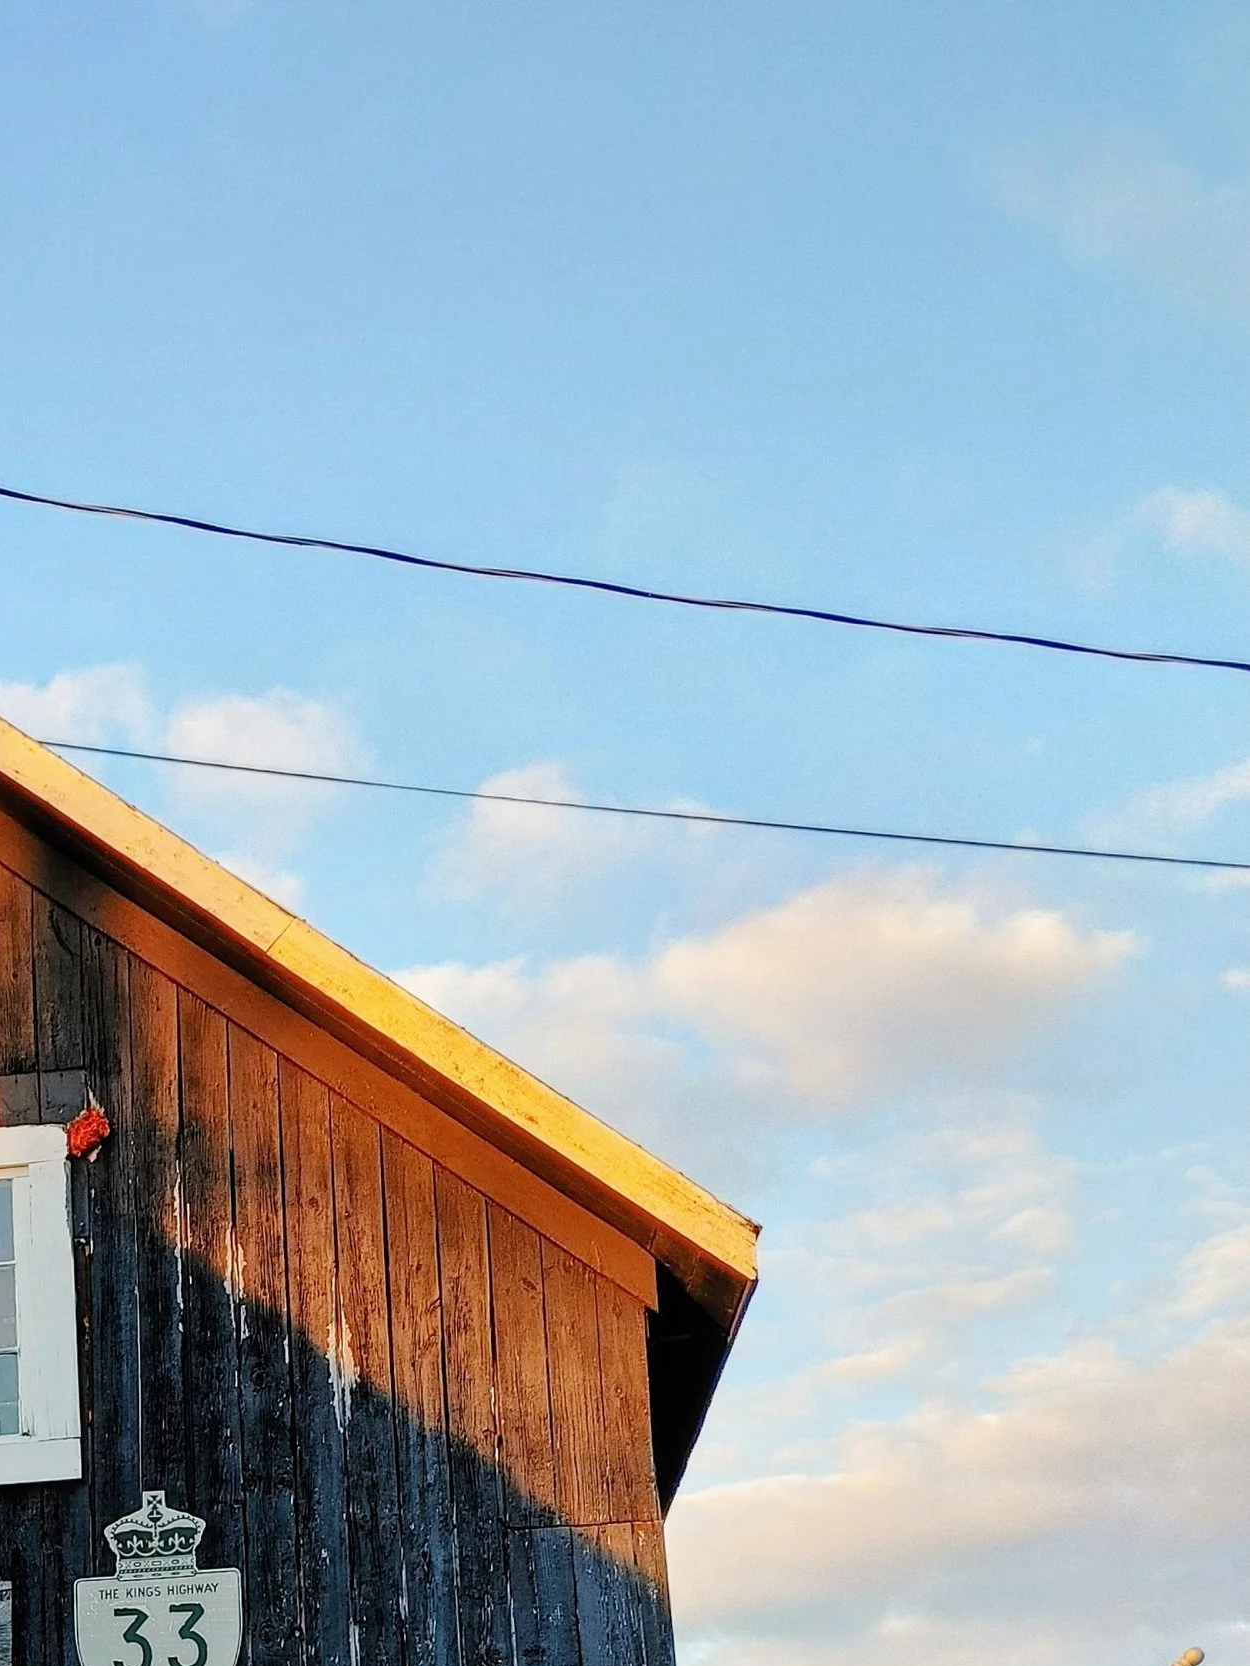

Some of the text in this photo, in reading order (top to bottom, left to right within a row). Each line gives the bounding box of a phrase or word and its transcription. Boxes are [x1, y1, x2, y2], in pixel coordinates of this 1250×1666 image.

[99, 1583, 219, 1600] THE KINGS HIGHWAY
